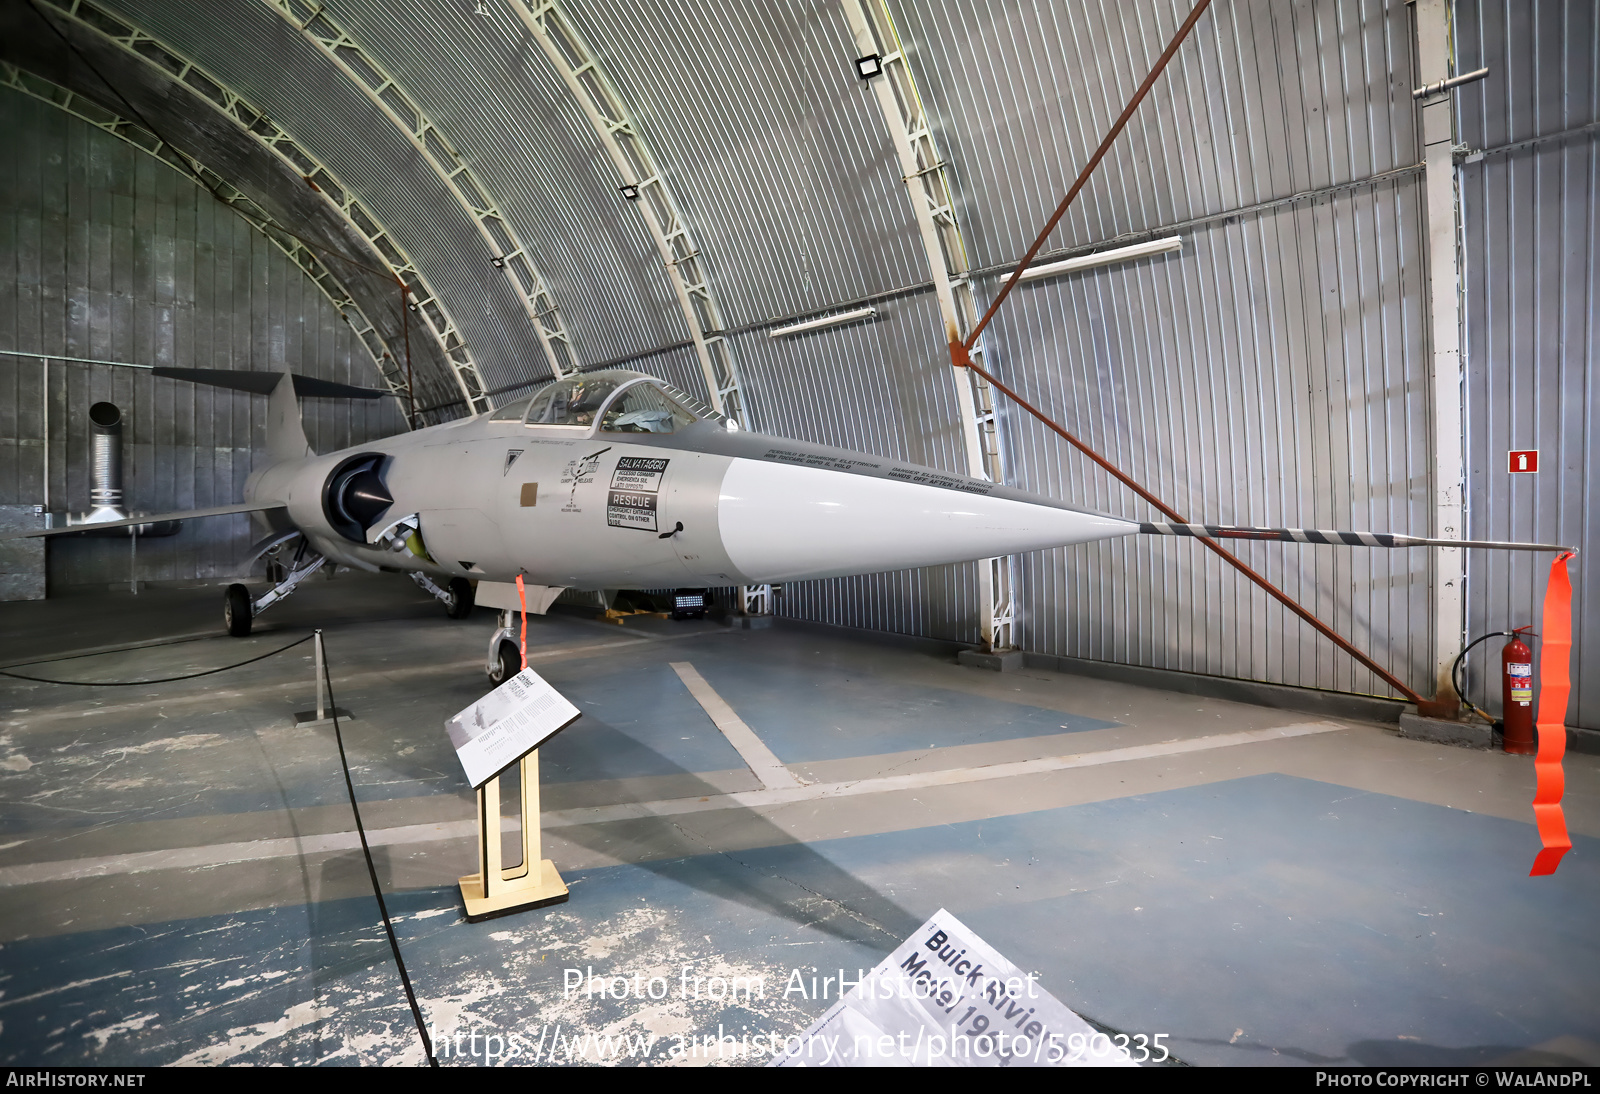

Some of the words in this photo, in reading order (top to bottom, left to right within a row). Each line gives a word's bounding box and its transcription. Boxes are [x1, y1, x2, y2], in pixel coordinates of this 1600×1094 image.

[619, 458, 666, 470] SALVATAGGIO
[778, 455, 806, 463] TOCCARE
[888, 471, 912, 480] HANDS
[929, 479, 953, 487] AFTER
[955, 484, 989, 494] LANDING
[891, 467, 920, 475] DANGER
[921, 472, 964, 484] ELECTRICAL
[613, 494, 650, 508] RESCUE
[609, 506, 632, 514] EMERGENCY
[633, 508, 655, 517] ENTRANCE
[609, 512, 628, 520] CONTROL
[925, 929, 984, 988] Buick
[900, 951, 965, 1014] Model
